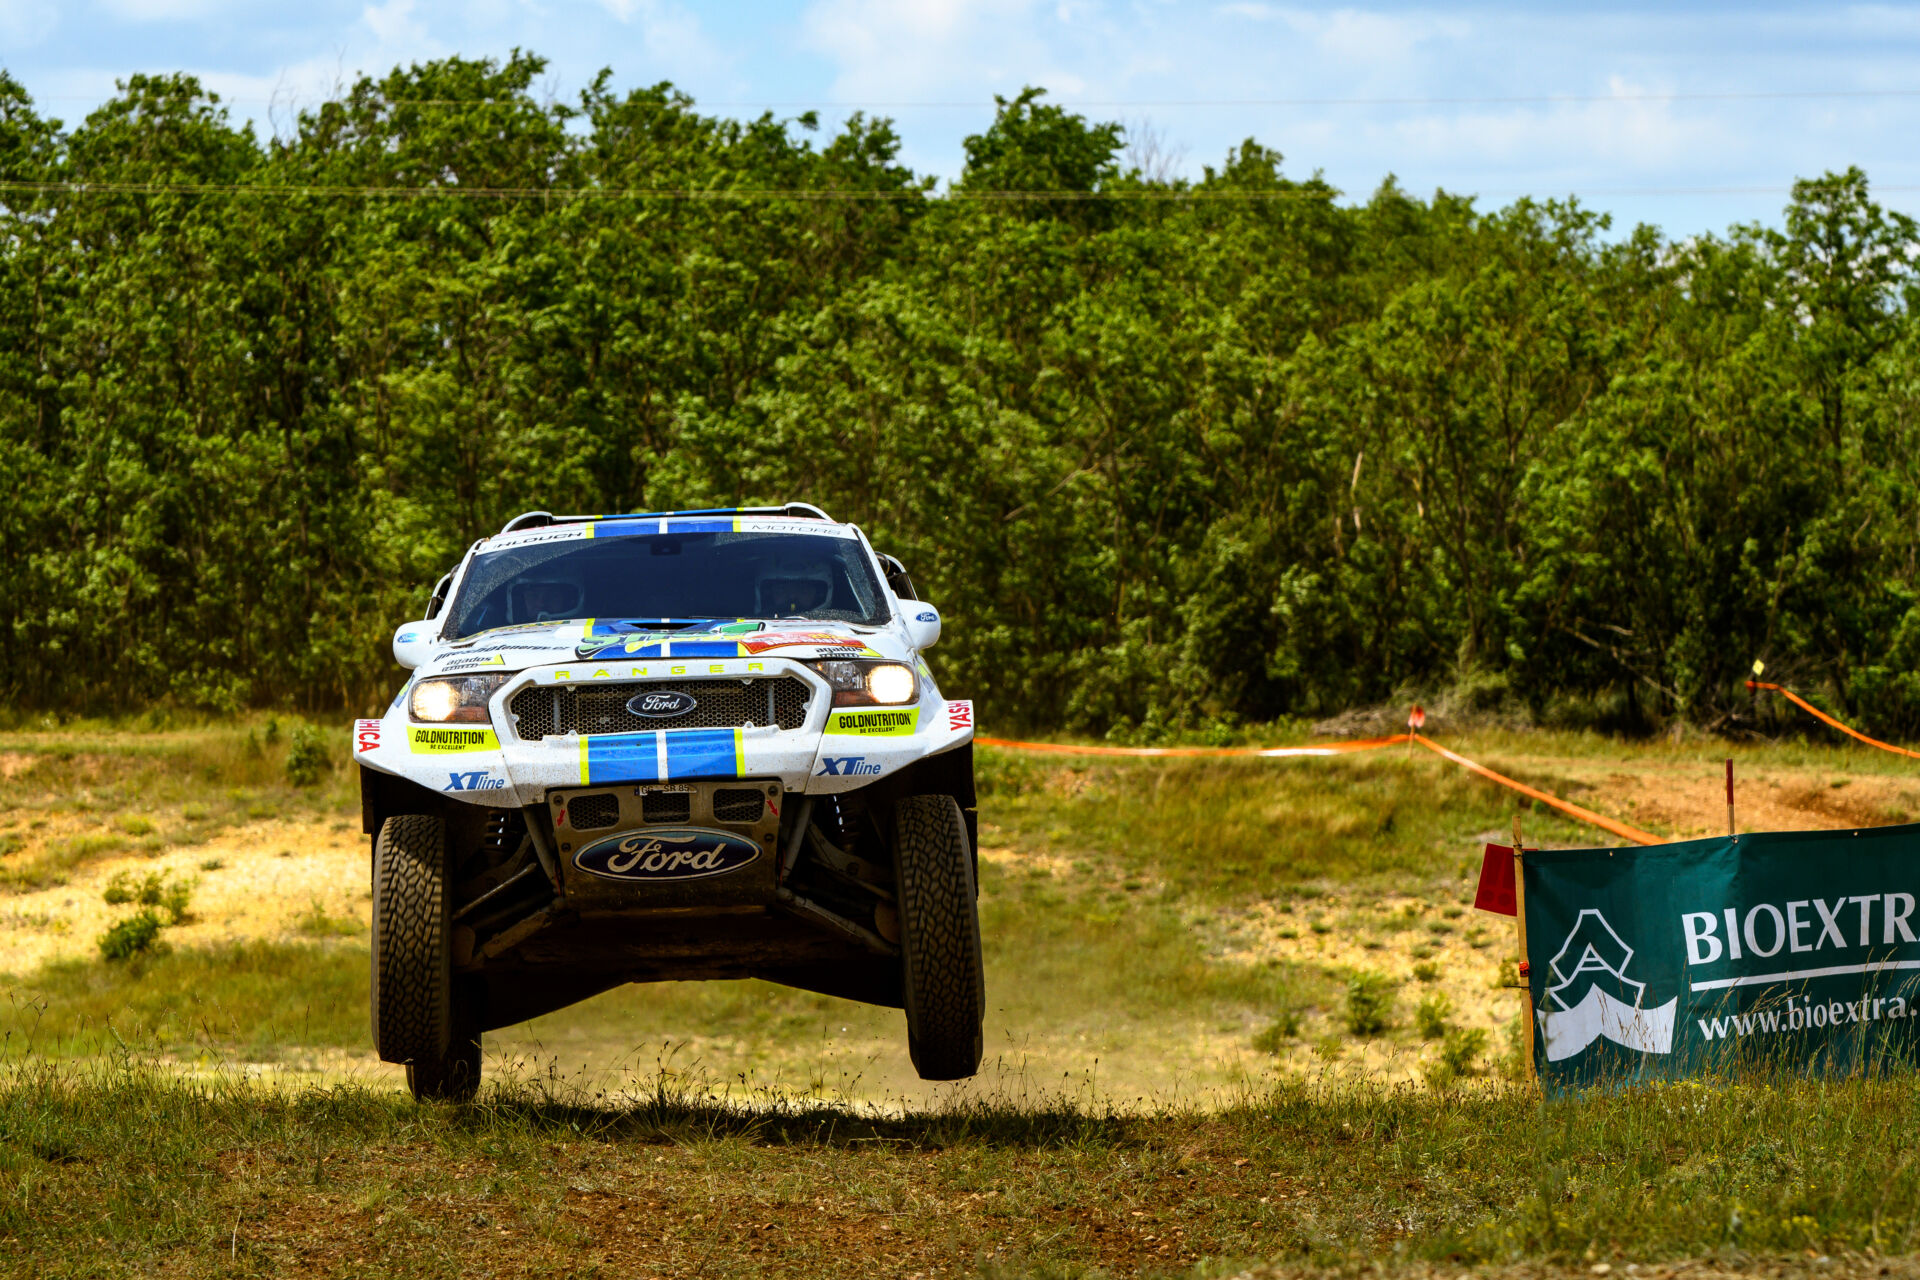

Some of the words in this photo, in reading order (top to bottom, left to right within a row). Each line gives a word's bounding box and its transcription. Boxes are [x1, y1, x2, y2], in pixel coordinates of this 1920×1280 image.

[496, 531, 582, 549] HLOUCH
[751, 524, 841, 535] MOTORS
[815, 645, 863, 655] agados
[446, 655, 493, 667] agados
[554, 662, 764, 680] RANGER
[642, 694, 680, 710] Ford
[839, 712, 911, 728] GOLDNUTRITION
[415, 730, 485, 744] GOLDNUTRITION
[815, 756, 881, 776] XTline
[443, 771, 505, 791] XTline
[663, 784, 677, 792] SR
[607, 835, 727, 873] Ford
[1681, 891, 1920, 966] BIOEXTR
